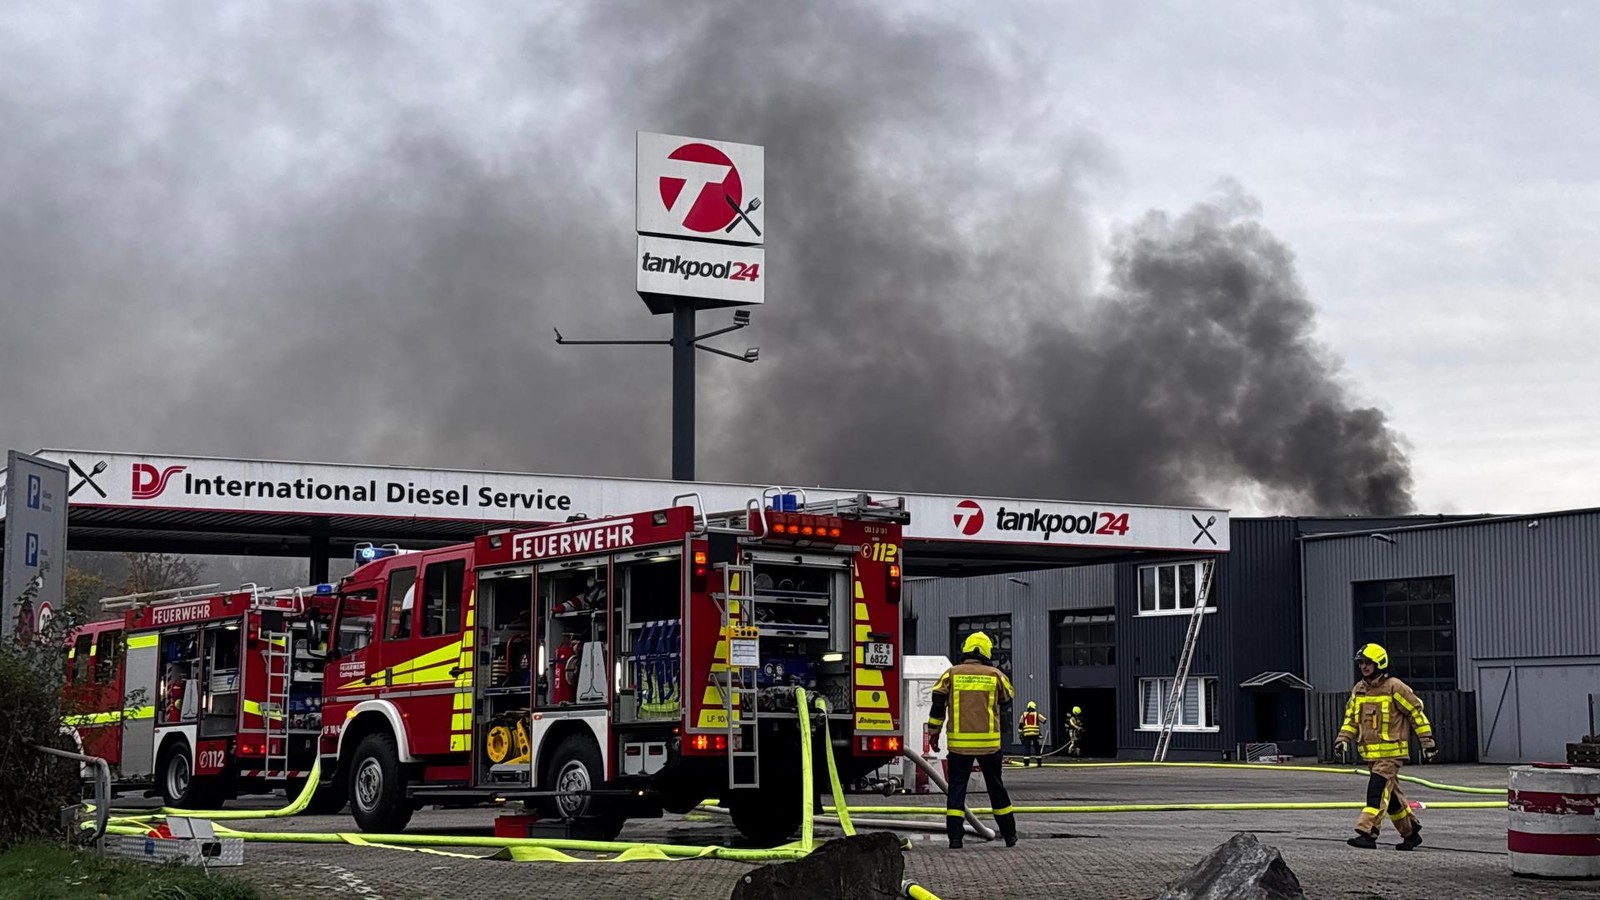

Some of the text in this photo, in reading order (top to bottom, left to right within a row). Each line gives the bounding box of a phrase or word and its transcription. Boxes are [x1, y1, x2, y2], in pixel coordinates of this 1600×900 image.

[642, 252, 760, 282] tankpool24
[185, 473, 376, 502] International
[386, 482, 468, 506] Diesel
[478, 487, 571, 510] Service
[996, 507, 1130, 540] tankpool24
[512, 517, 634, 560] FEUERWEHR
[872, 543, 898, 562] 112
[152, 600, 211, 625] FEUERWEHR
[870, 654, 888, 664] 6822
[873, 644, 884, 654] RE
[207, 750, 225, 768] 112
